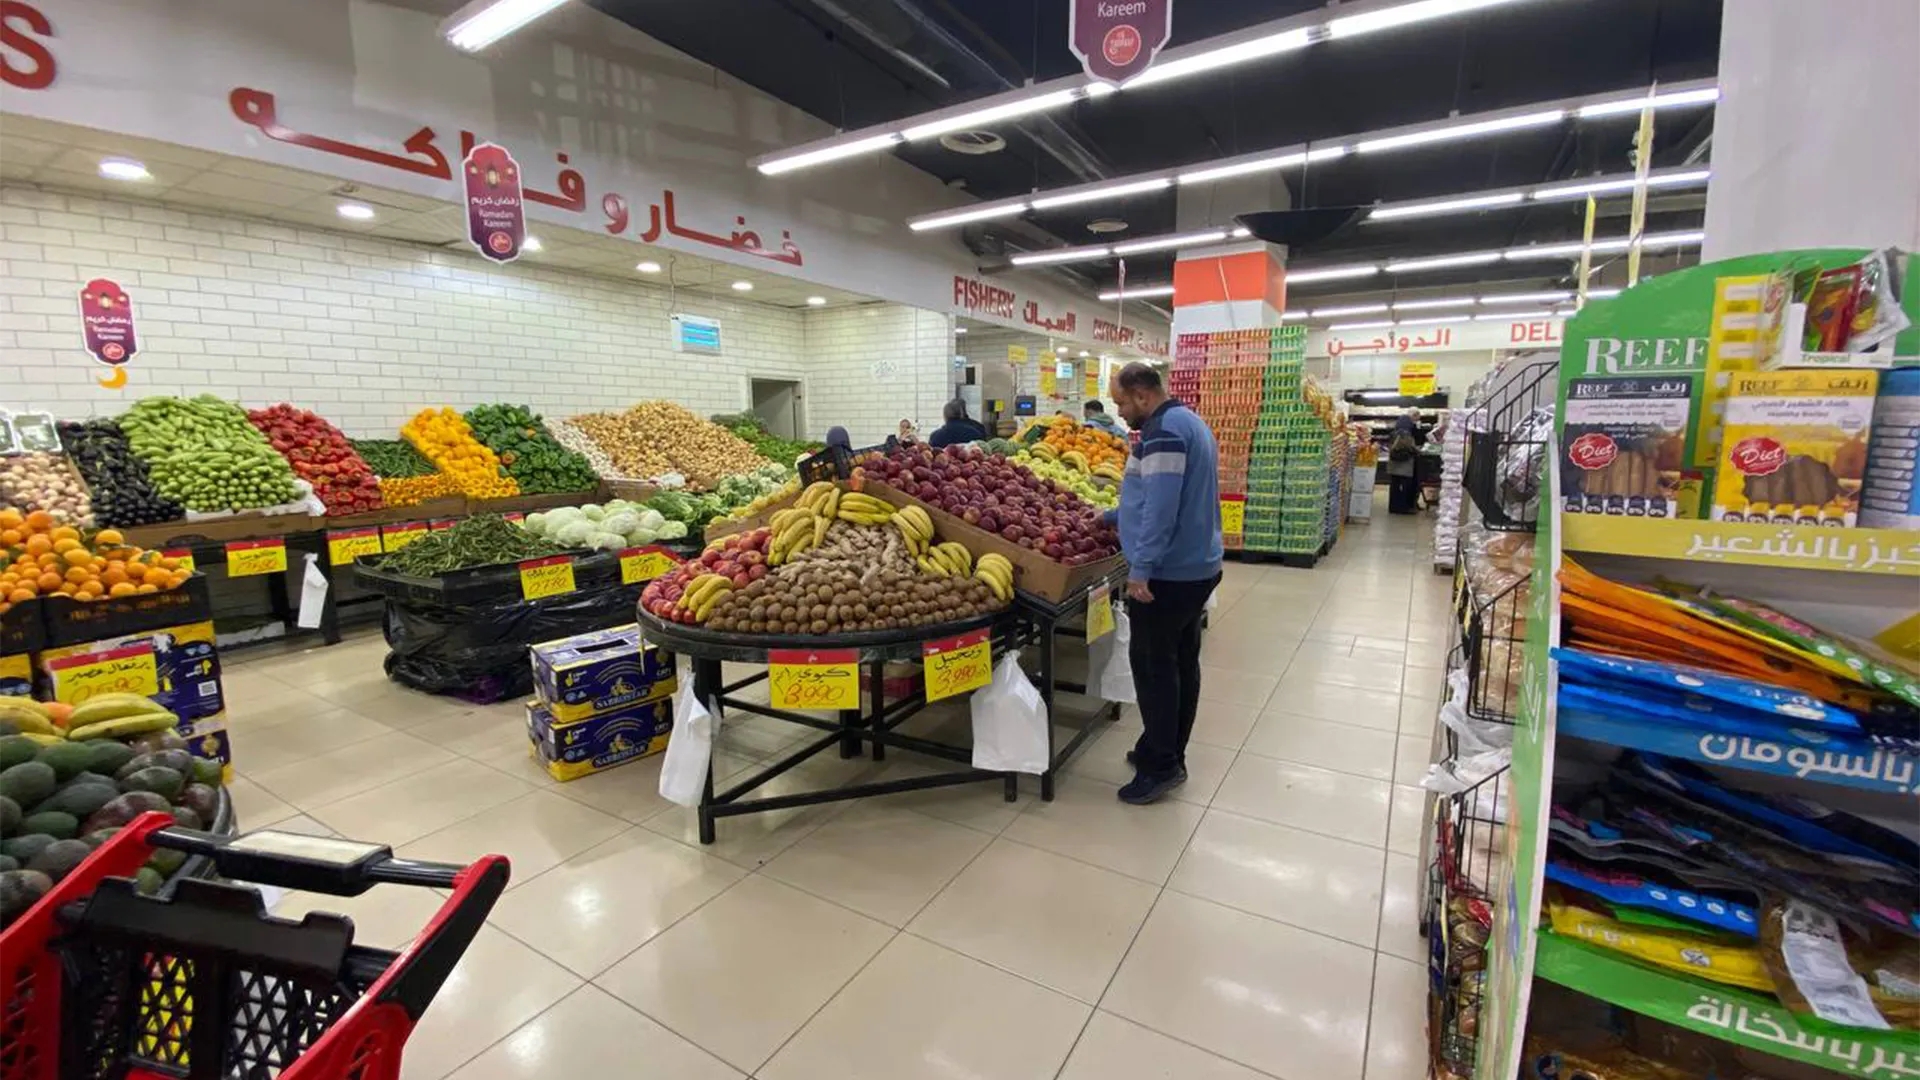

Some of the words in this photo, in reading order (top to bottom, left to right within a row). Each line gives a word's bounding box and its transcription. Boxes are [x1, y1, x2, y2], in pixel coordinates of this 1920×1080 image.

[1097, 1, 1147, 17] Kareem
[228, 87, 586, 213] فاكه
[602, 192, 629, 235] و
[640, 189, 803, 267] خضار
[954, 275, 1016, 319] FISHERY
[1327, 327, 1451, 358] الدواجن
[1582, 336, 1711, 375] REEF
[1579, 444, 1613, 459] Diet
[1741, 448, 1783, 464] Diet
[1685, 528, 1857, 568] بالشعير
